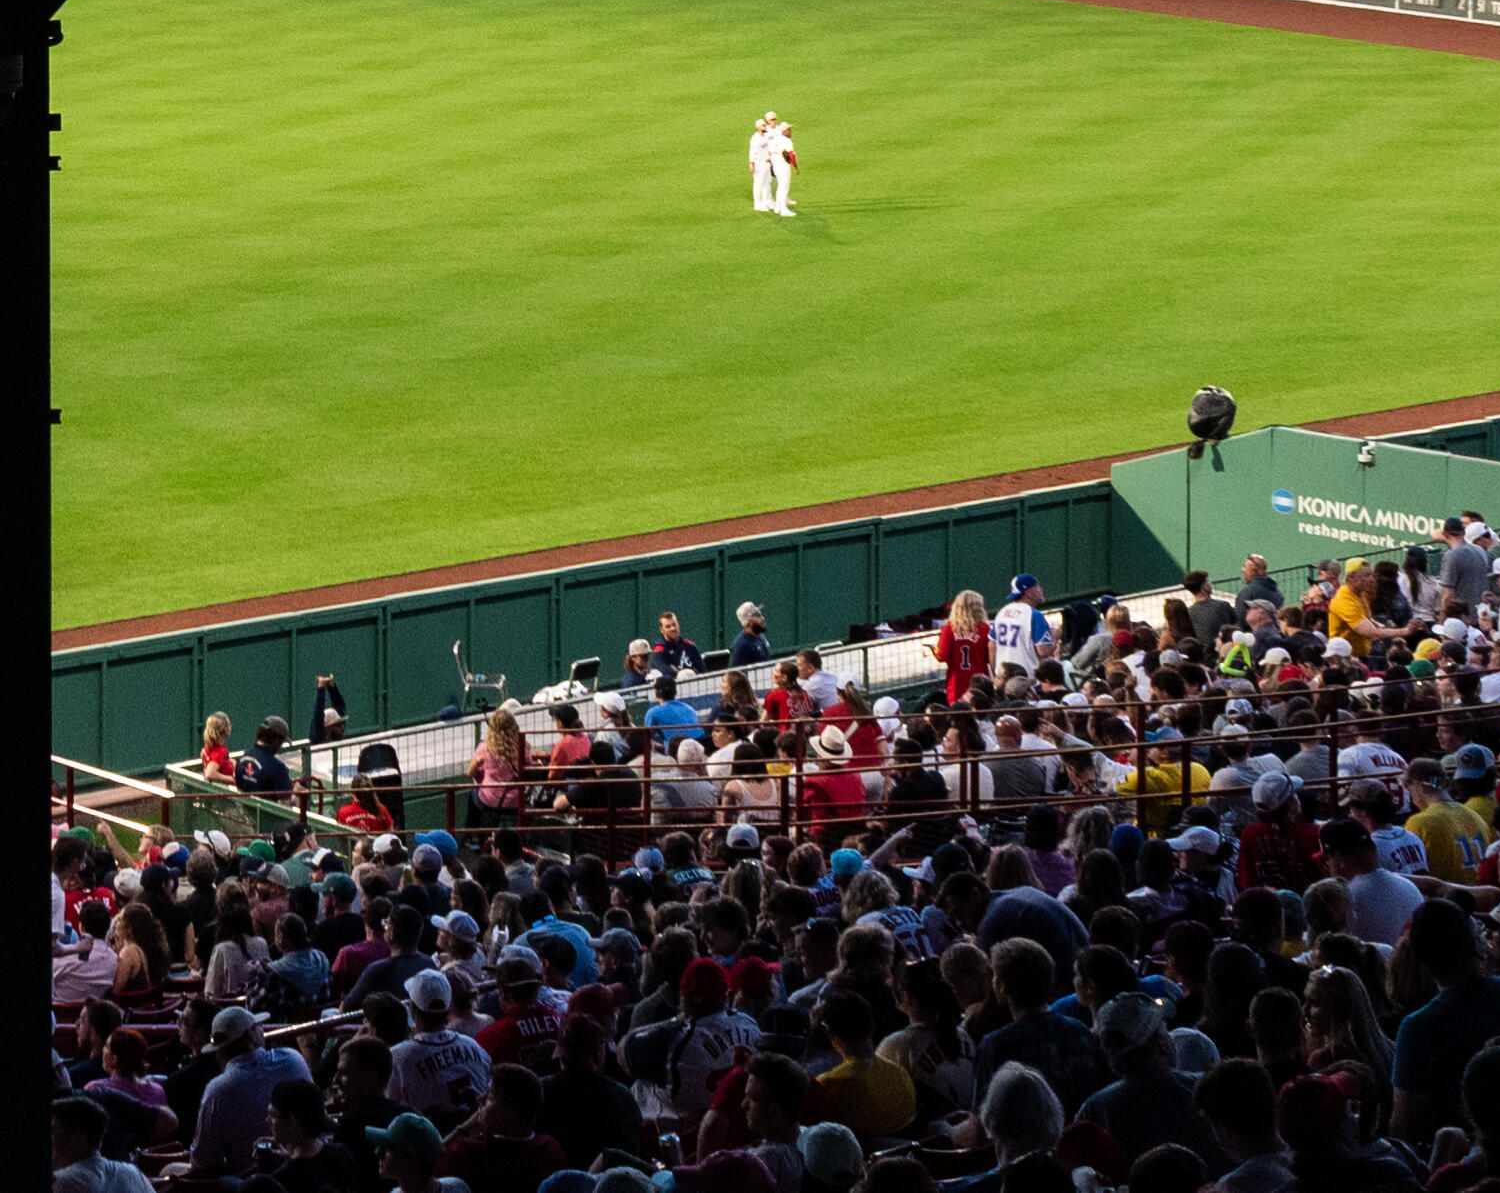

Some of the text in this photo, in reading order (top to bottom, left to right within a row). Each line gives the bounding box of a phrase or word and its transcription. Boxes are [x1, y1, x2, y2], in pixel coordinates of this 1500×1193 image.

[1298, 495, 1446, 536] KONICA MINOLT
[999, 623, 1021, 649] 27
[959, 644, 971, 670] 1
[516, 1015, 562, 1038] RILEY
[417, 1045, 482, 1078] FREEMAN
